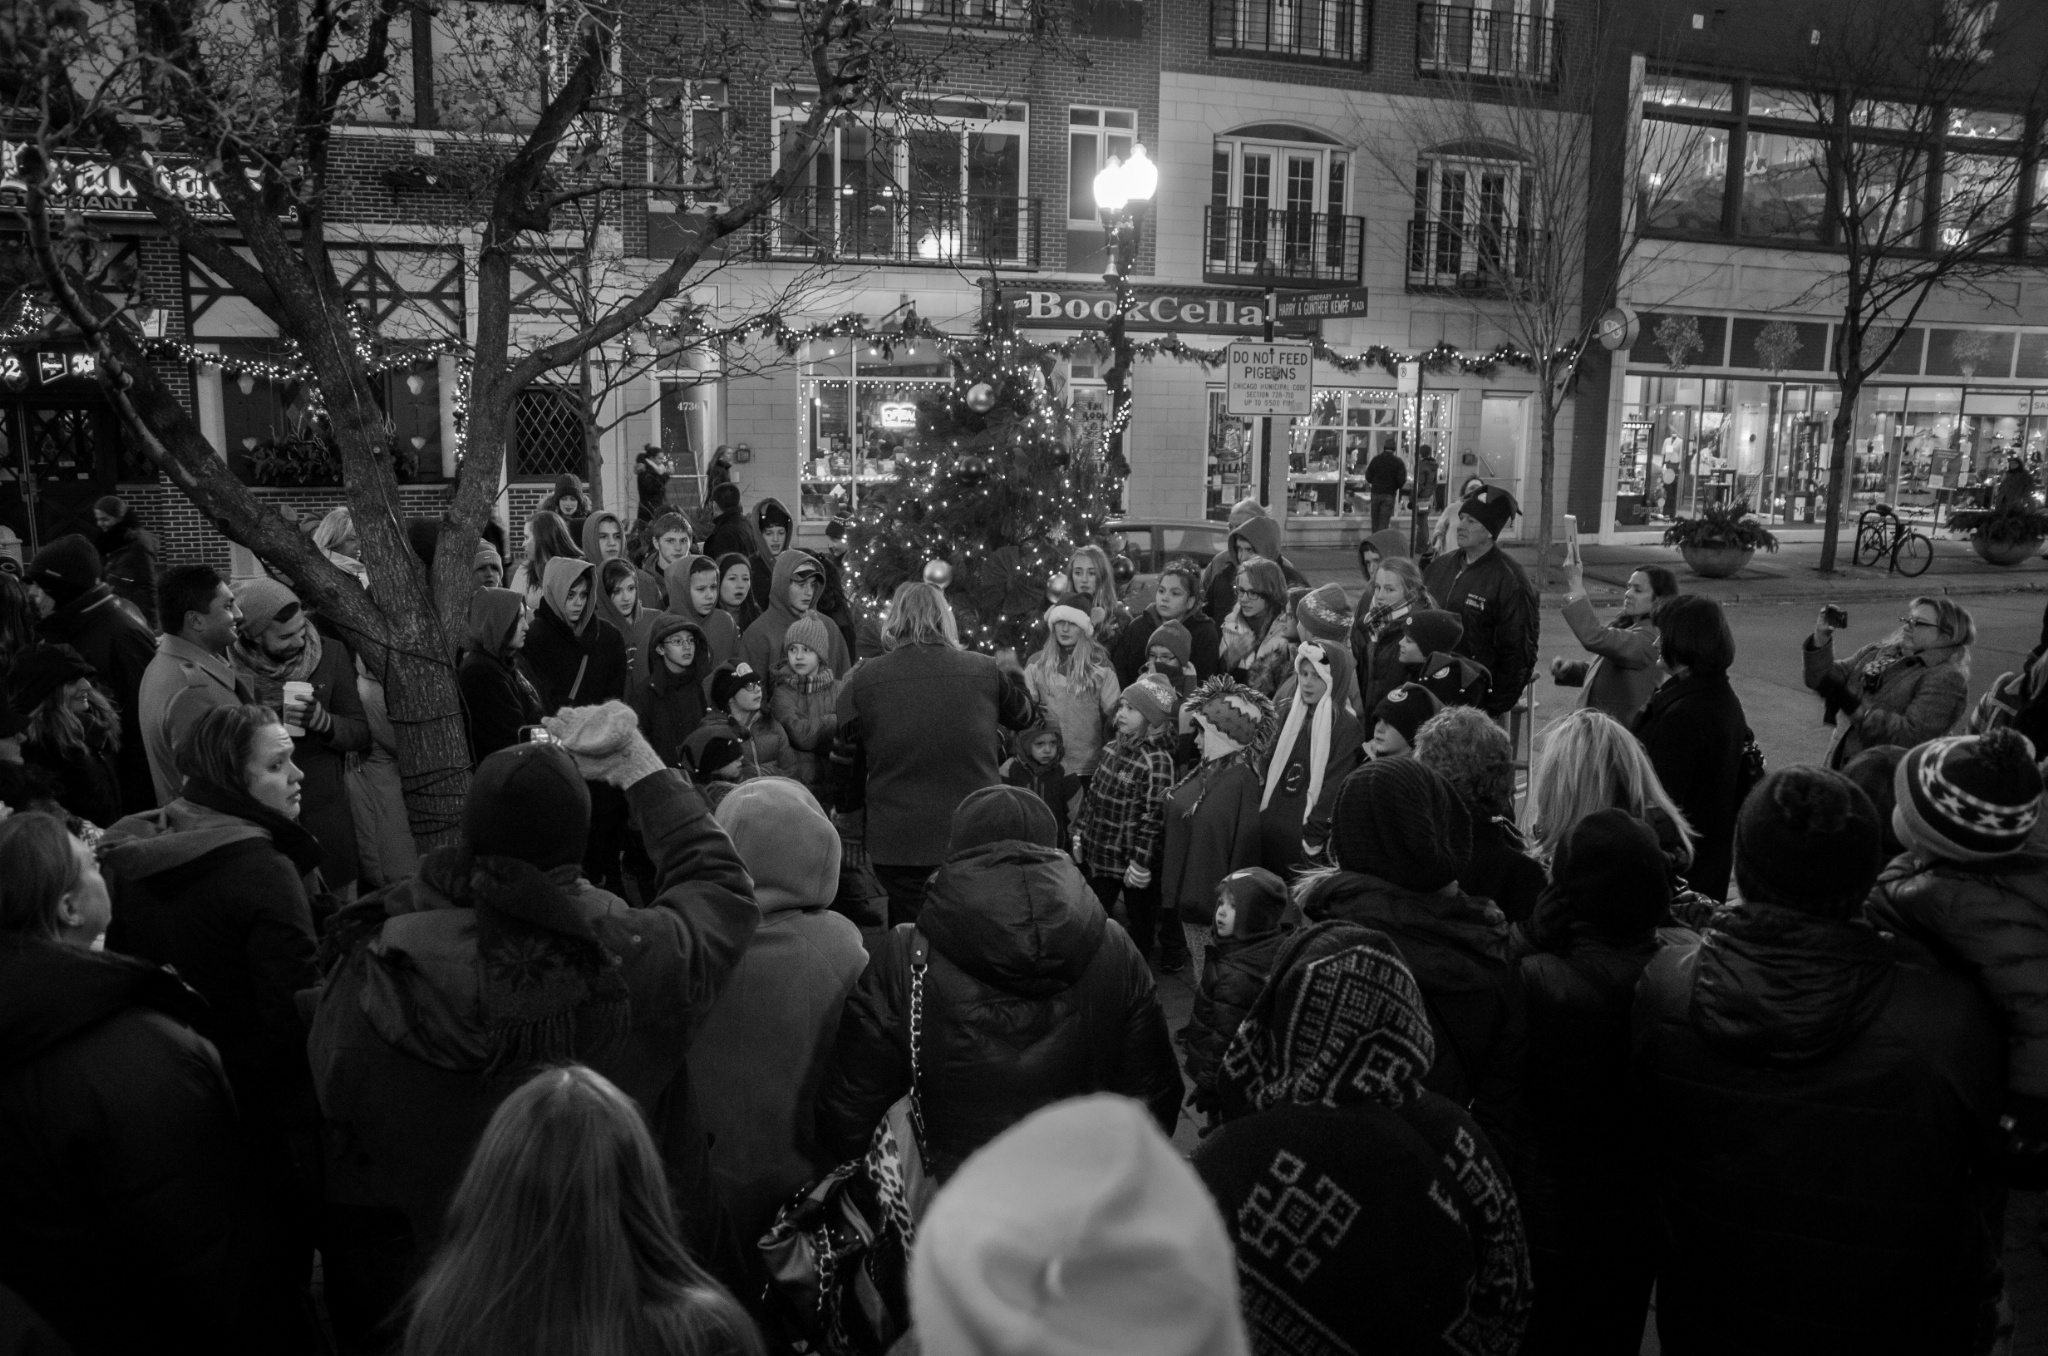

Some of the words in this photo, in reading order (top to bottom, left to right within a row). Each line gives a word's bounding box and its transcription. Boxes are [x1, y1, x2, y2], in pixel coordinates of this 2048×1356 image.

[1307, 293, 1333, 302] HONORARY
[1026, 291, 1284, 327] BookCella
[1278, 303, 1296, 316] HARRY
[1298, 302, 1302, 316] &
[1303, 301, 1329, 315] GUNTHER
[1330, 300, 1350, 314] KEMPF
[1351, 301, 1365, 311] PLAZA
[1233, 351, 1249, 364] DO
[1253, 351, 1275, 365] NOT
[1279, 352, 1308, 366] FEED
[1233, 382, 1258, 390] CHICAGO
[1260, 383, 1290, 391] MUNICIPAL
[1292, 384, 1307, 392] CODE
